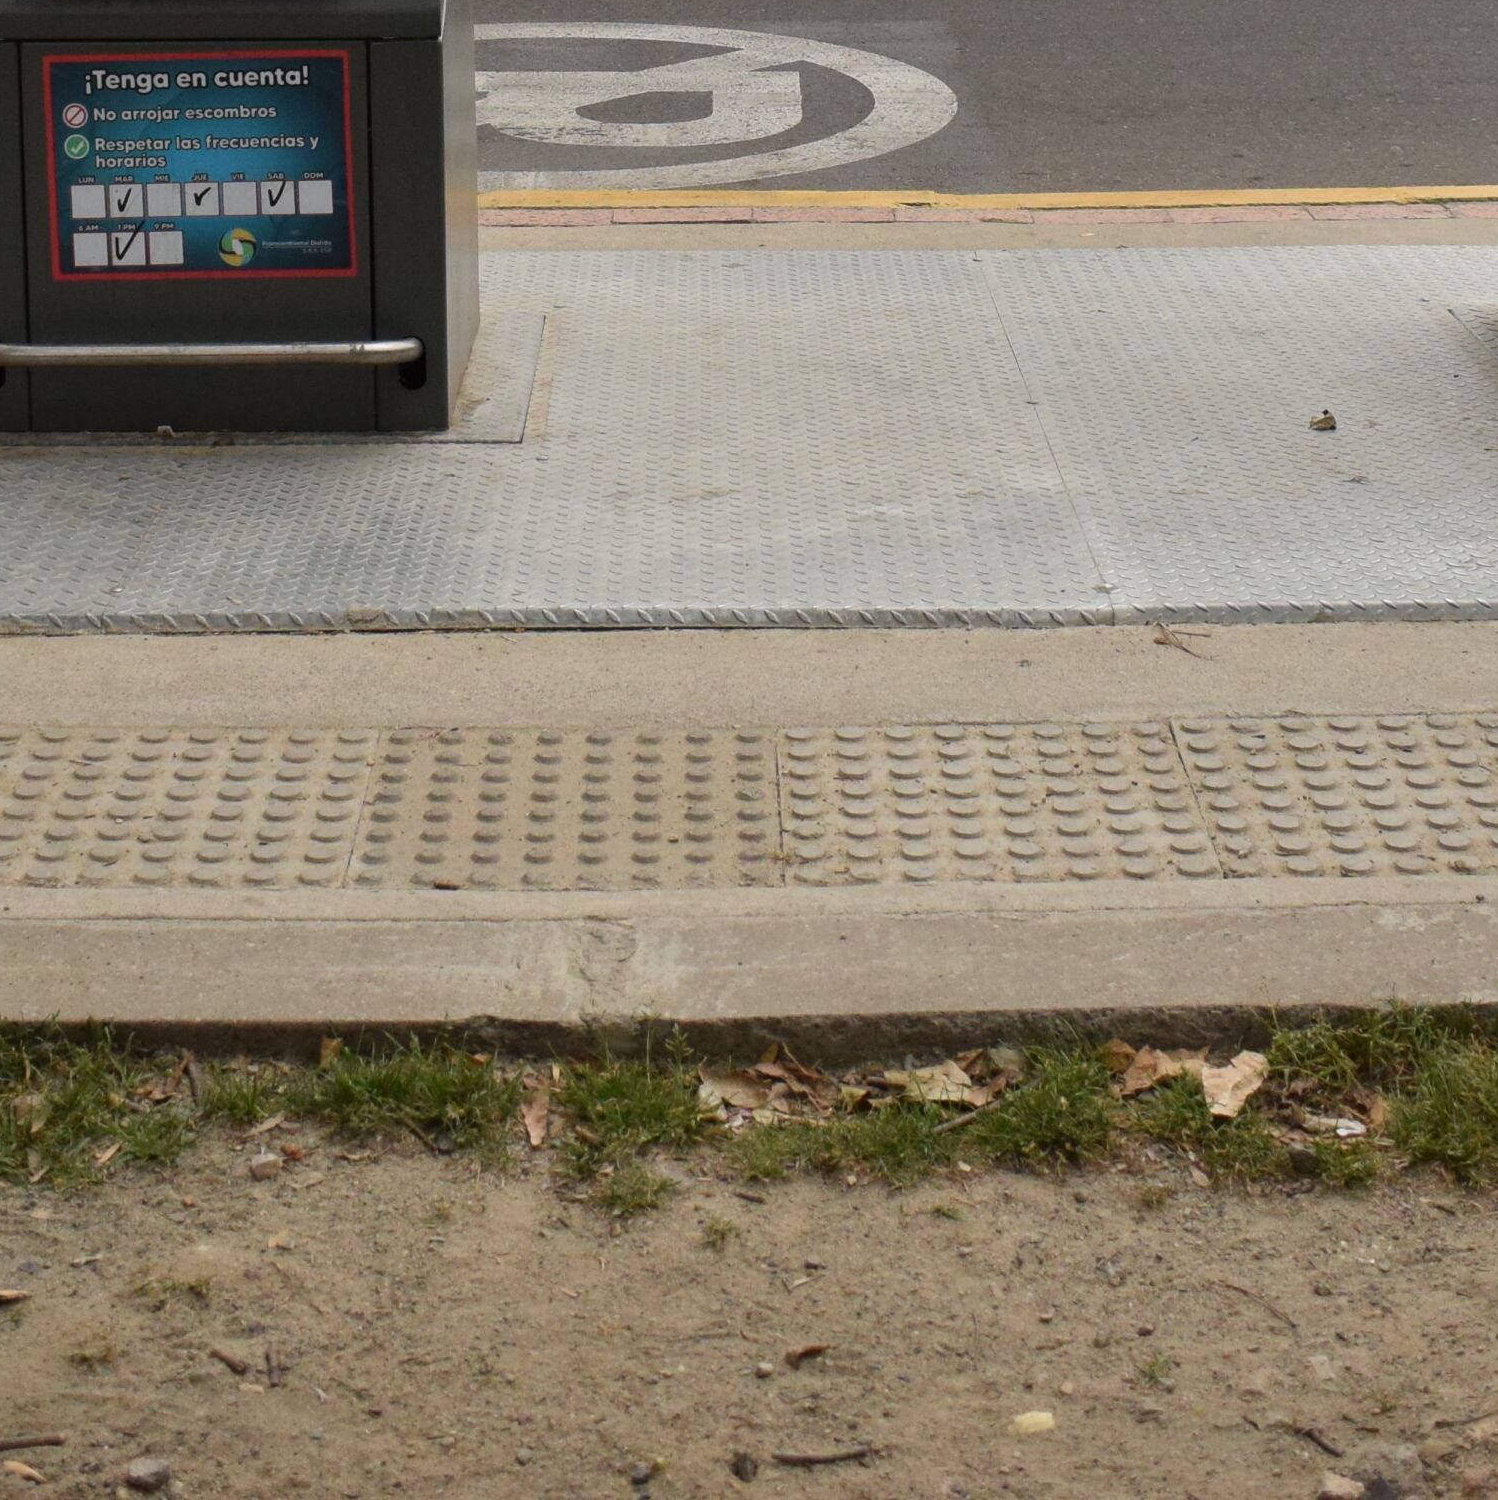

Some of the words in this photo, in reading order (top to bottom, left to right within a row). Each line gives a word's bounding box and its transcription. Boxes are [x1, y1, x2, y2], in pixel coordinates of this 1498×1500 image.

[85, 69, 169, 95] ¡Tenga
[176, 71, 207, 87] en
[214, 65, 309, 87] cuenta!
[93, 107, 117, 121] No
[121, 106, 180, 123] arrojar
[185, 105, 277, 119] escombros
[94, 137, 171, 153] Respetar
[176, 136, 200, 150] las
[206, 134, 304, 149] frecuencias
[310, 136, 319, 150] y
[95, 154, 166, 168] horarios
